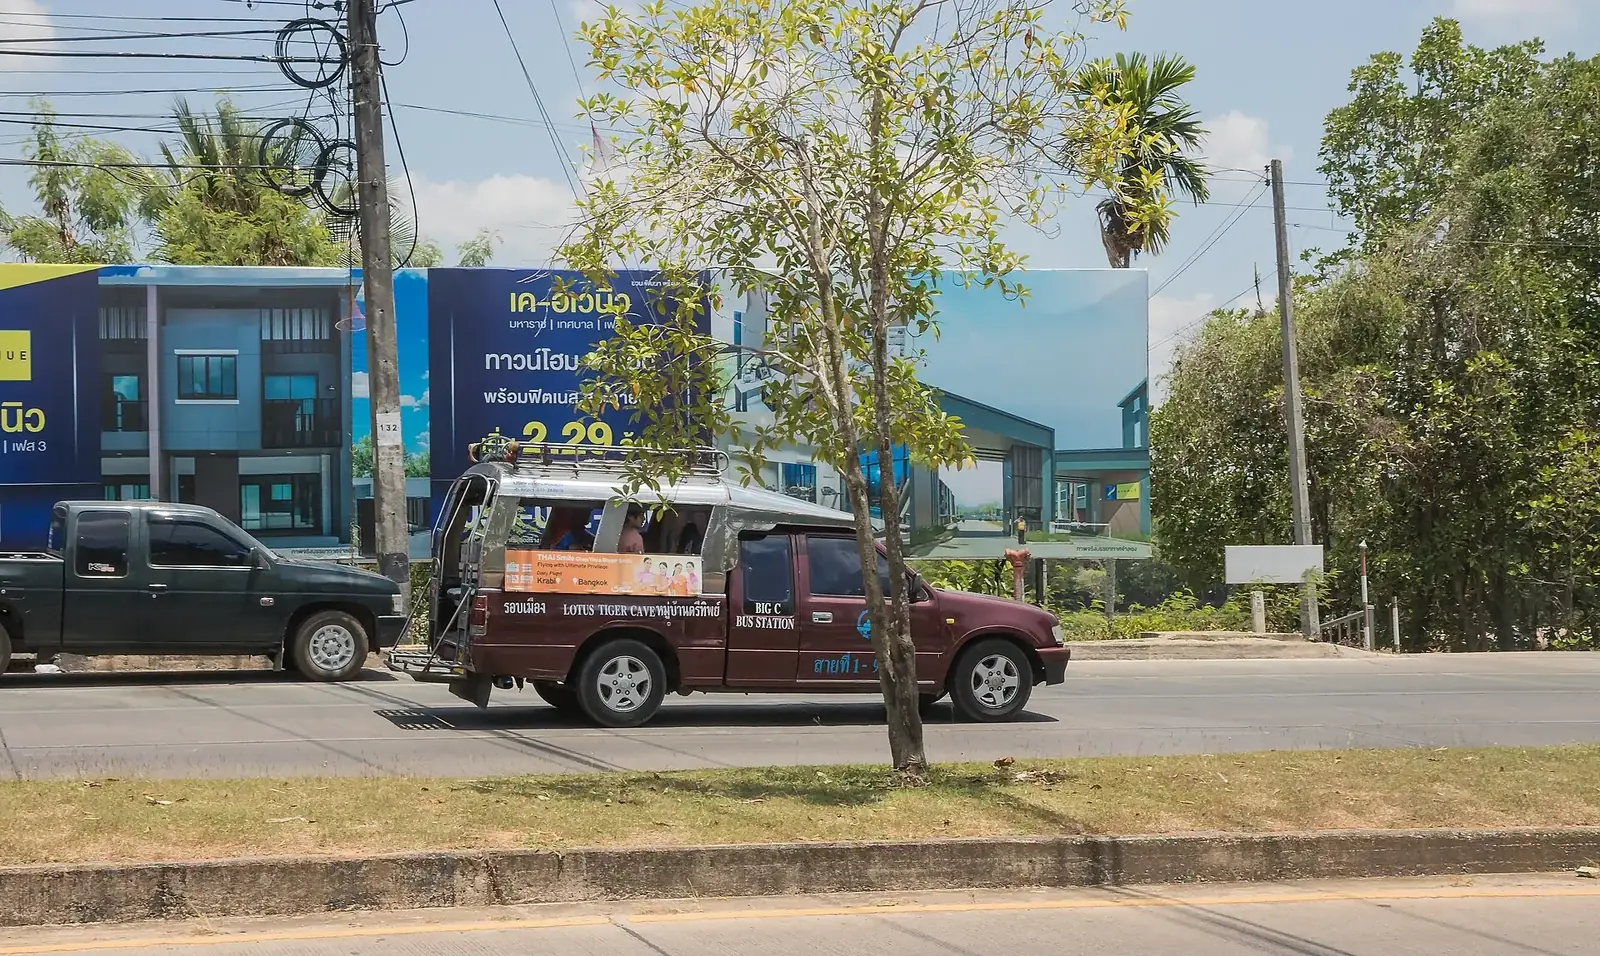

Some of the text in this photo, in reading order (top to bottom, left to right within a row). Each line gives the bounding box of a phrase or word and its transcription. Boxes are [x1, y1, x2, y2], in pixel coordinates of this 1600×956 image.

[509, 319, 547, 330] มหาราช
[557, 319, 594, 330] เทศบาล
[0, 350, 27, 361] UE
[485, 348, 579, 371] ทาวน์โฮม
[380, 424, 397, 432] 132
[522, 421, 613, 455] 2.29
[12, 440, 47, 452] เฟส 3
[537, 553, 556, 561] THAI
[556, 553, 575, 562] Smile
[537, 577, 556, 585] Krabi
[578, 578, 608, 587] Bangkok
[503, 597, 546, 614] รอบเมือง
[563, 603, 656, 617] LOTUS TIGER CAVE
[755, 602, 782, 614] BIG C
[736, 615, 795, 630] BUS STATION
[814, 653, 851, 674] สายที่
